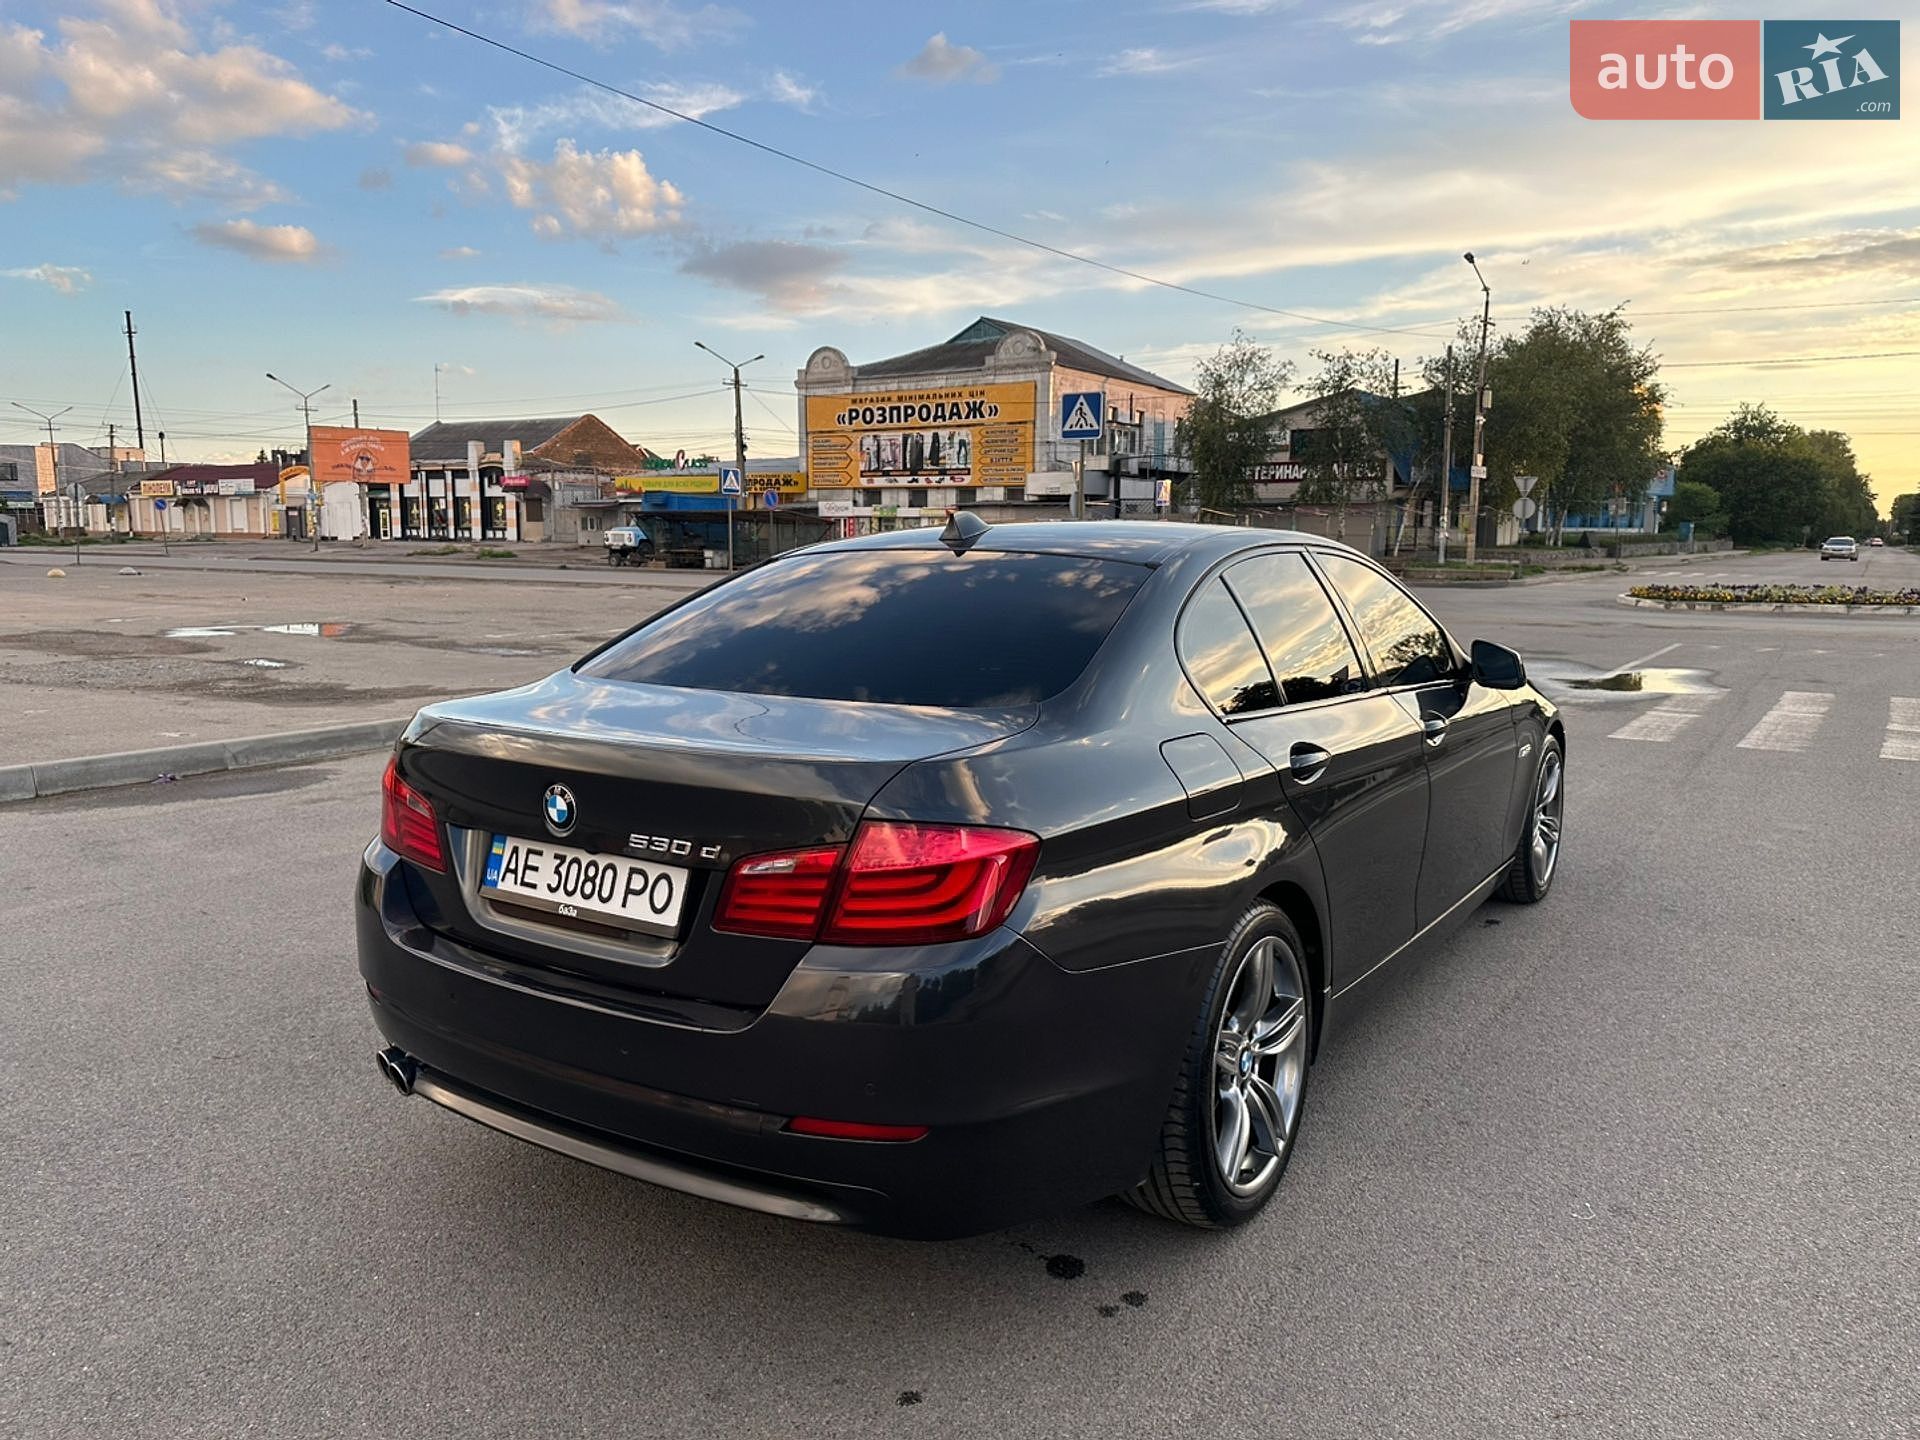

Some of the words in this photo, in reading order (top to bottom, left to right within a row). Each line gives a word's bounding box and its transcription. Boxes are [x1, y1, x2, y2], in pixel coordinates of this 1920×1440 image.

[852, 396, 892, 404] МАГАЗИН
[897, 391, 963, 402] МІНІМАЛЬНИХ
[969, 390, 985, 398] ЦІН
[837, 400, 999, 426] «РОЗПРОДАЖ»
[628, 833, 692, 856] 530
[700, 844, 722, 860] d
[486, 869, 498, 881] UA
[501, 844, 544, 890] AE
[546, 852, 618, 904] 3080
[621, 865, 674, 915] PO
